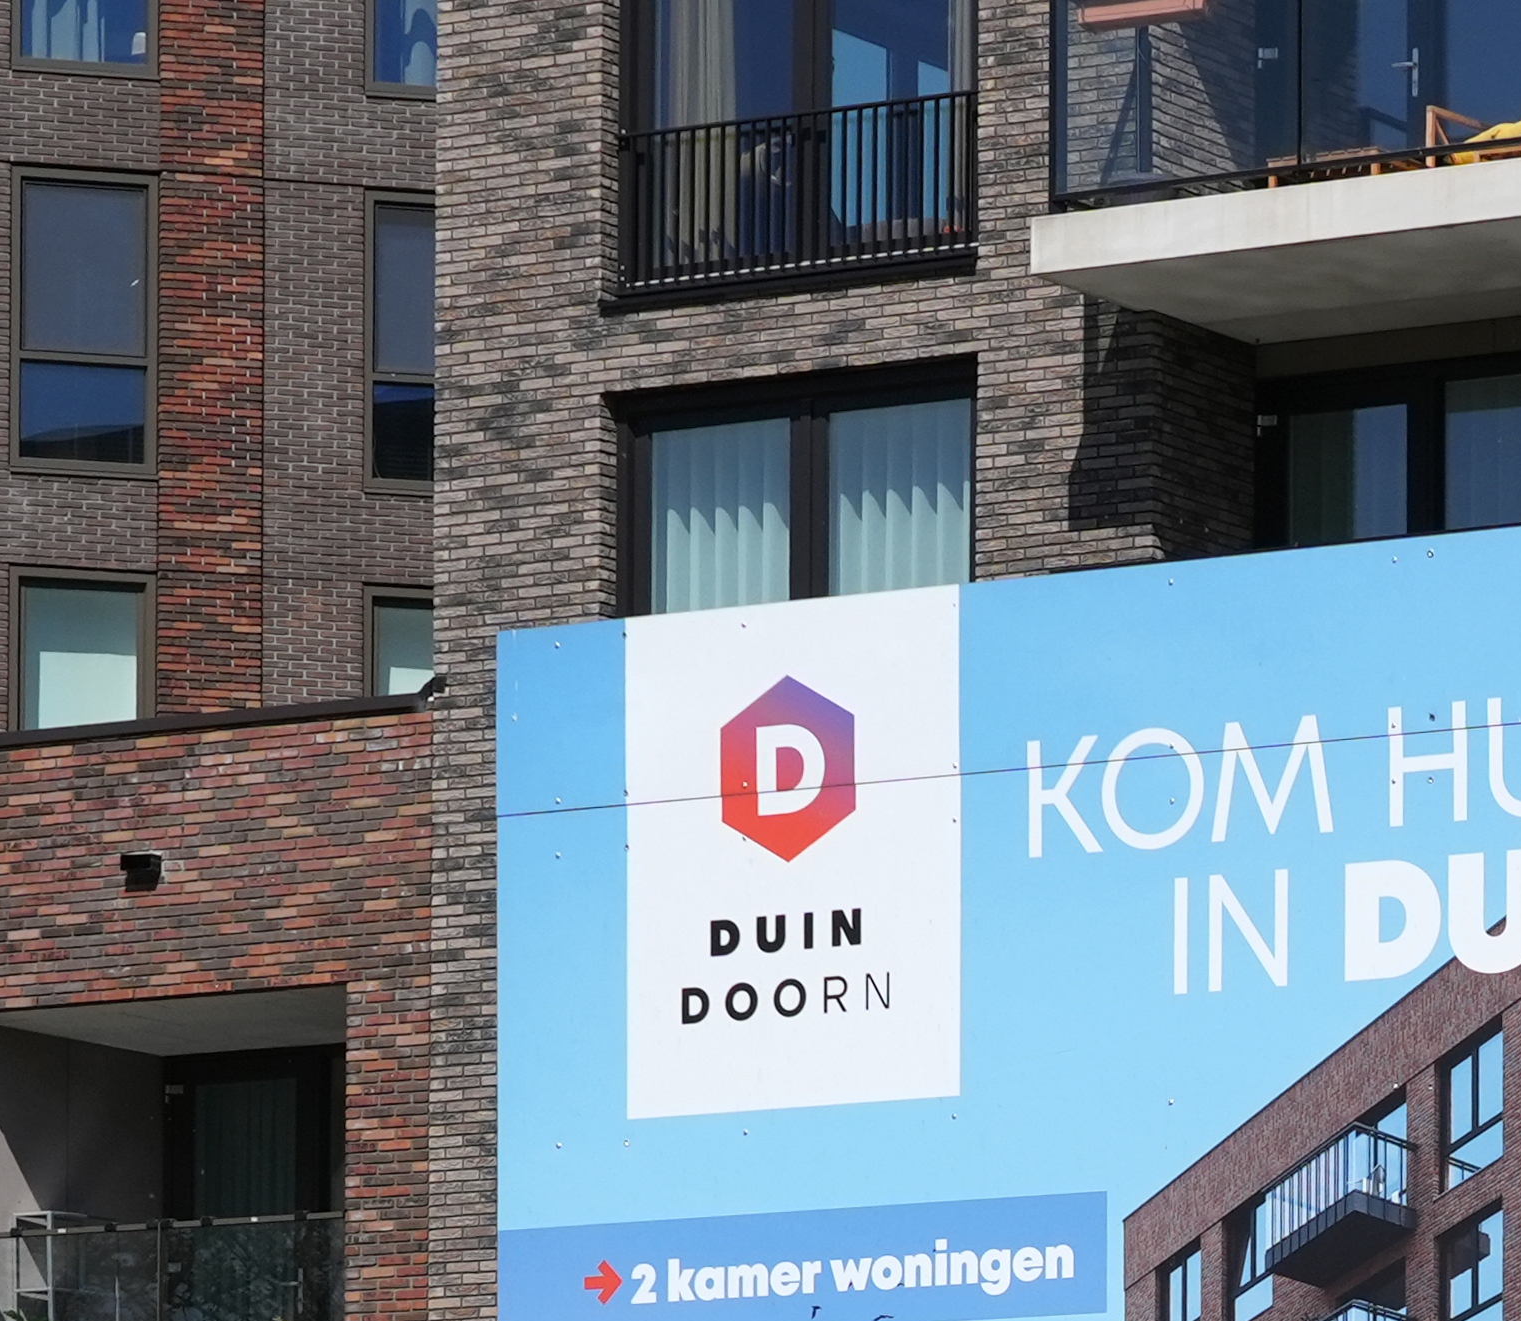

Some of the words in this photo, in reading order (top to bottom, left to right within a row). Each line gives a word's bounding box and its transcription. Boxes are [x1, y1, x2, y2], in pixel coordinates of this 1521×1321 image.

[755, 723, 826, 817] D
[1027, 715, 1333, 858] KOM
[710, 908, 862, 956] DUIN
[1172, 869, 1287, 995] IN
[681, 971, 890, 1024] DOORN
[630, 1263, 657, 1305] 2
[668, 1258, 822, 1302] kamer
[830, 1239, 1075, 1296] woningen
